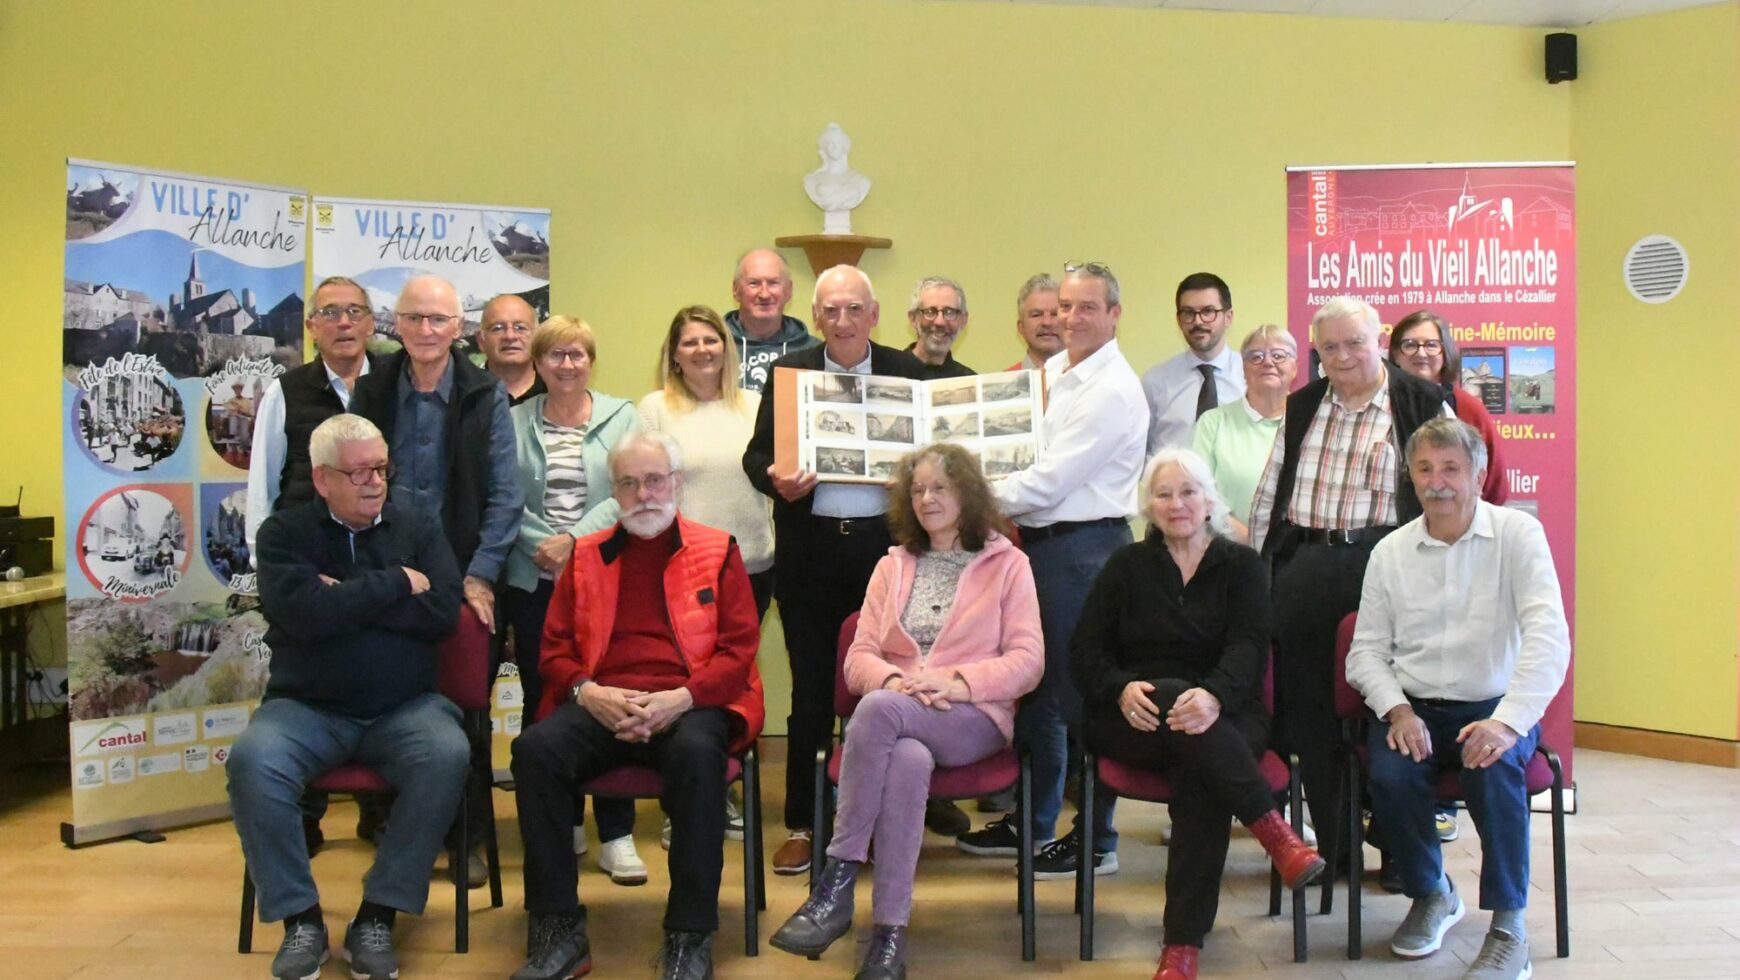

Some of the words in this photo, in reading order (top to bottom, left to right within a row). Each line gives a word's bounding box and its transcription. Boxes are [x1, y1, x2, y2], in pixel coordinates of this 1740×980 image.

[152, 182, 217, 219] VILLE
[228, 191, 249, 221] D'
[188, 206, 297, 252] Allanche
[355, 209, 421, 239] VILLE
[432, 213, 455, 240] D'
[379, 226, 493, 264] Allanche
[1307, 241, 1341, 289] Les
[1346, 240, 1395, 288] Amis
[1400, 239, 1424, 288] du
[1427, 238, 1469, 288] Vieil
[1474, 237, 1557, 287] Allanche
[1307, 292, 1362, 305] Assotion
[1365, 291, 1386, 304] crée
[1387, 294, 1400, 304] en
[1402, 291, 1424, 304] 1979
[1426, 291, 1432, 303] à
[1435, 290, 1476, 304] Allanche
[1478, 290, 1502, 303] dans
[1504, 289, 1513, 303] le
[1515, 288, 1557, 303] Cézallier
[1493, 418, 1556, 440] ieux...
[98, 730, 147, 748] cantal
